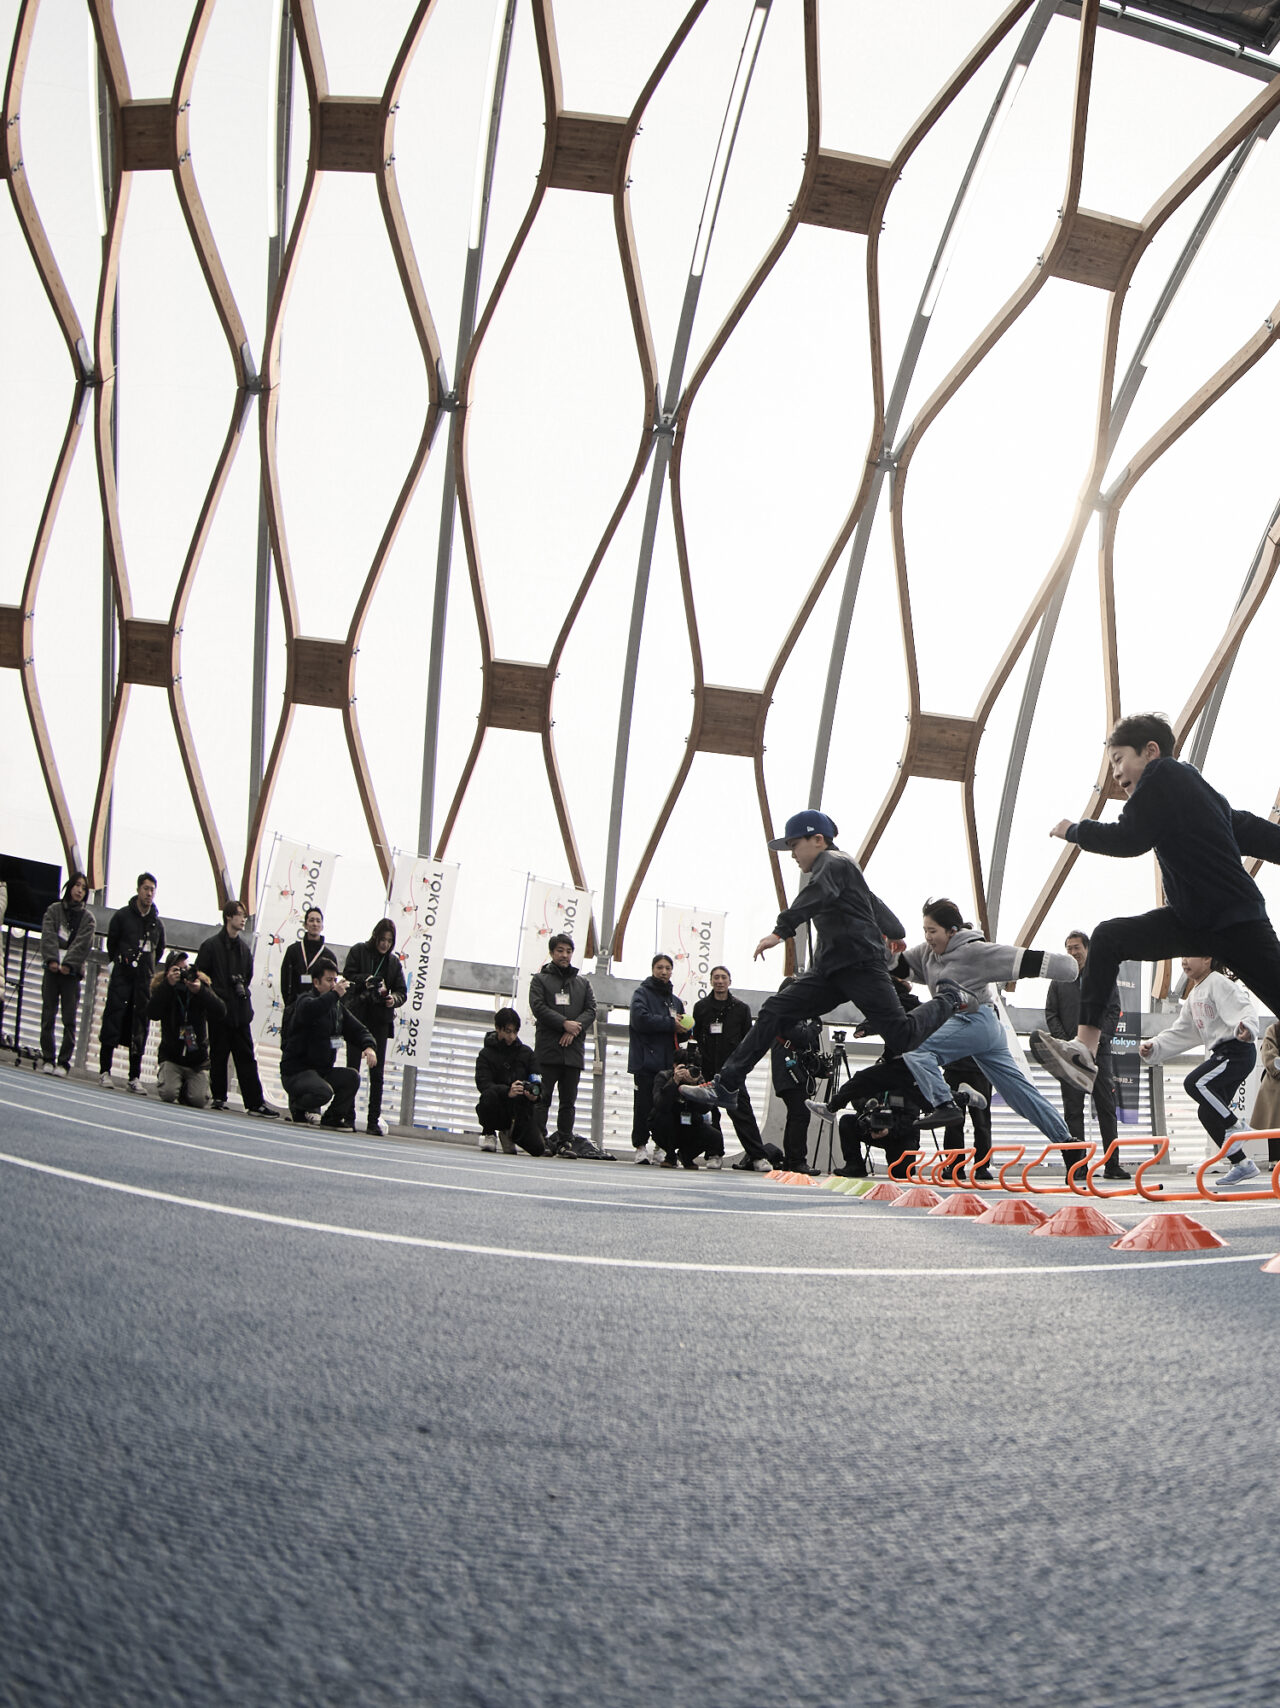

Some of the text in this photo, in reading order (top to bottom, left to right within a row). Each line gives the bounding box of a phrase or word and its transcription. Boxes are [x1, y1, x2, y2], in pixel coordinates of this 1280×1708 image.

[406, 872, 443, 1057] TOKYO FORWARD 2025
[698, 921, 712, 974] TOKYO
[1112, 1036, 1137, 1048] Tokyo
